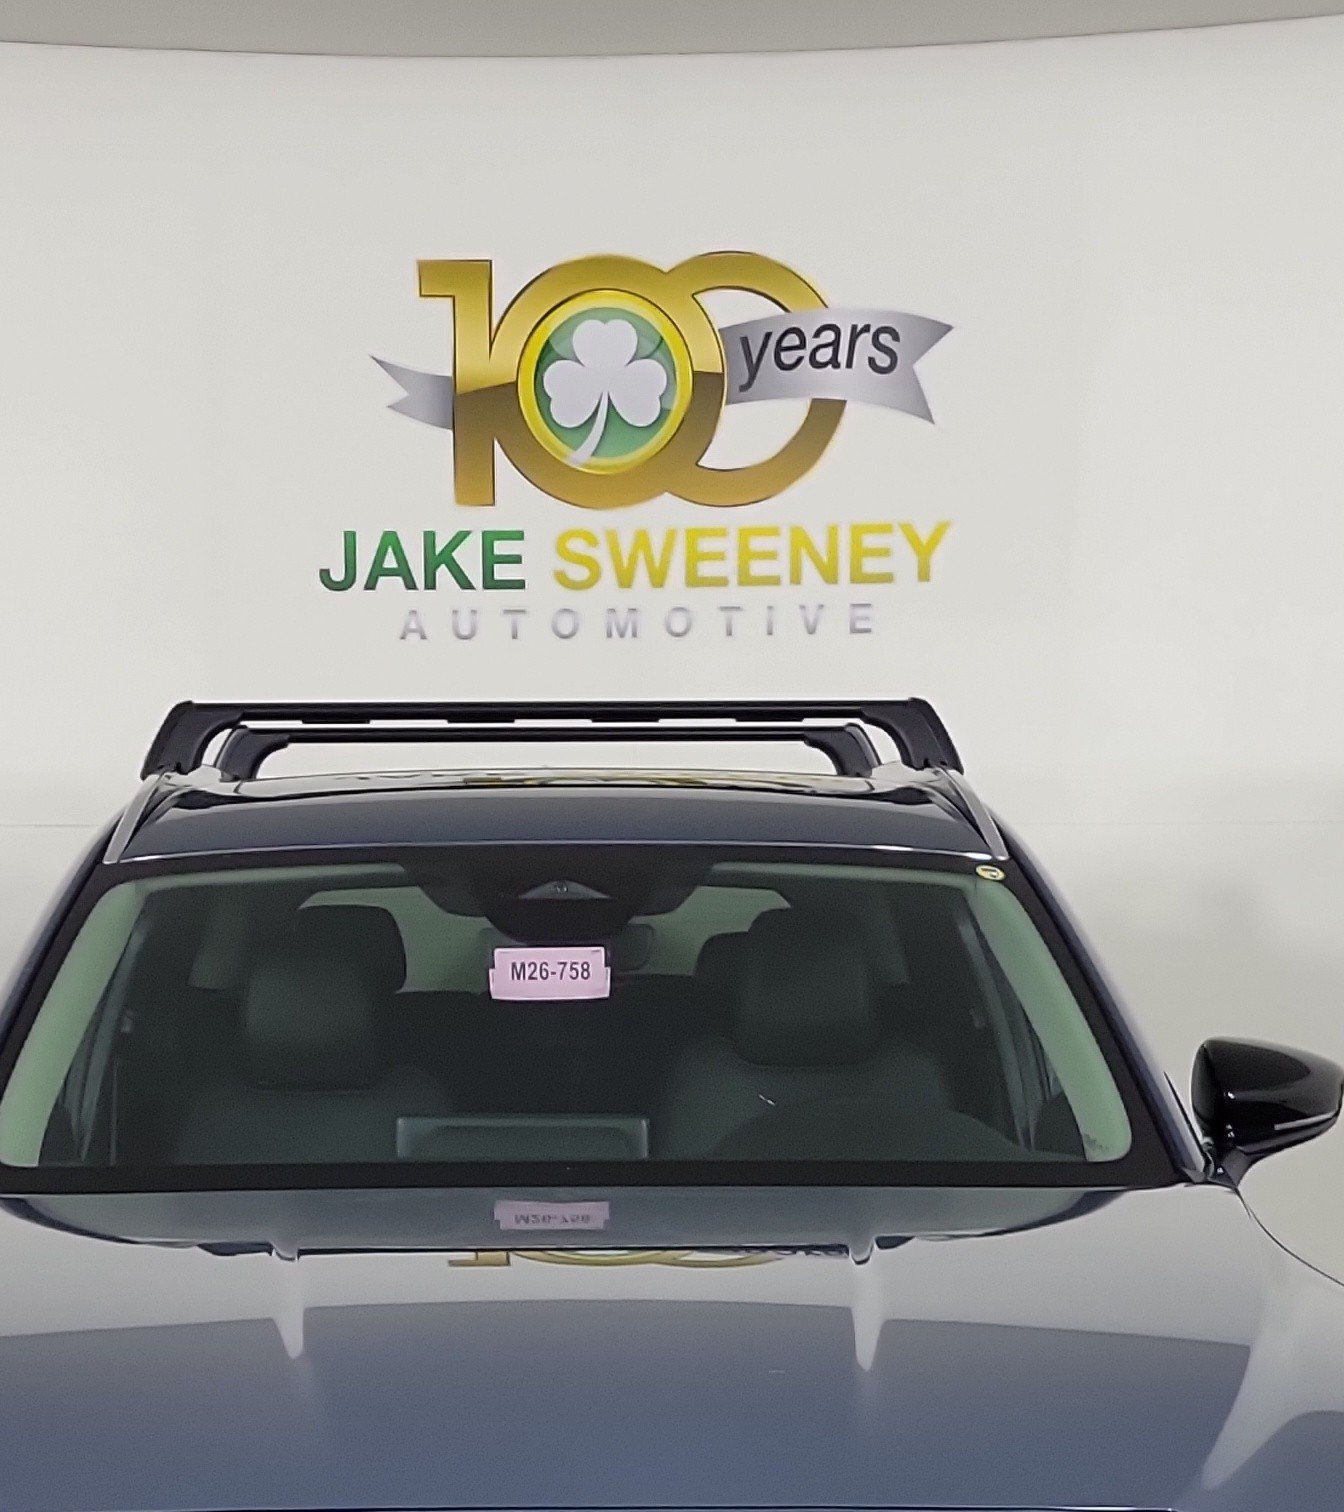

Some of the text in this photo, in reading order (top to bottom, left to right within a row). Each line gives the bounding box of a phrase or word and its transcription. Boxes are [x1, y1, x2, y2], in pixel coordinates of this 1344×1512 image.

[417, 251, 900, 509] 100 years
[319, 521, 951, 591] JAKE SWEENEY
[400, 602, 874, 641] AUTOMOTIVE
[511, 961, 591, 981] M26-758
